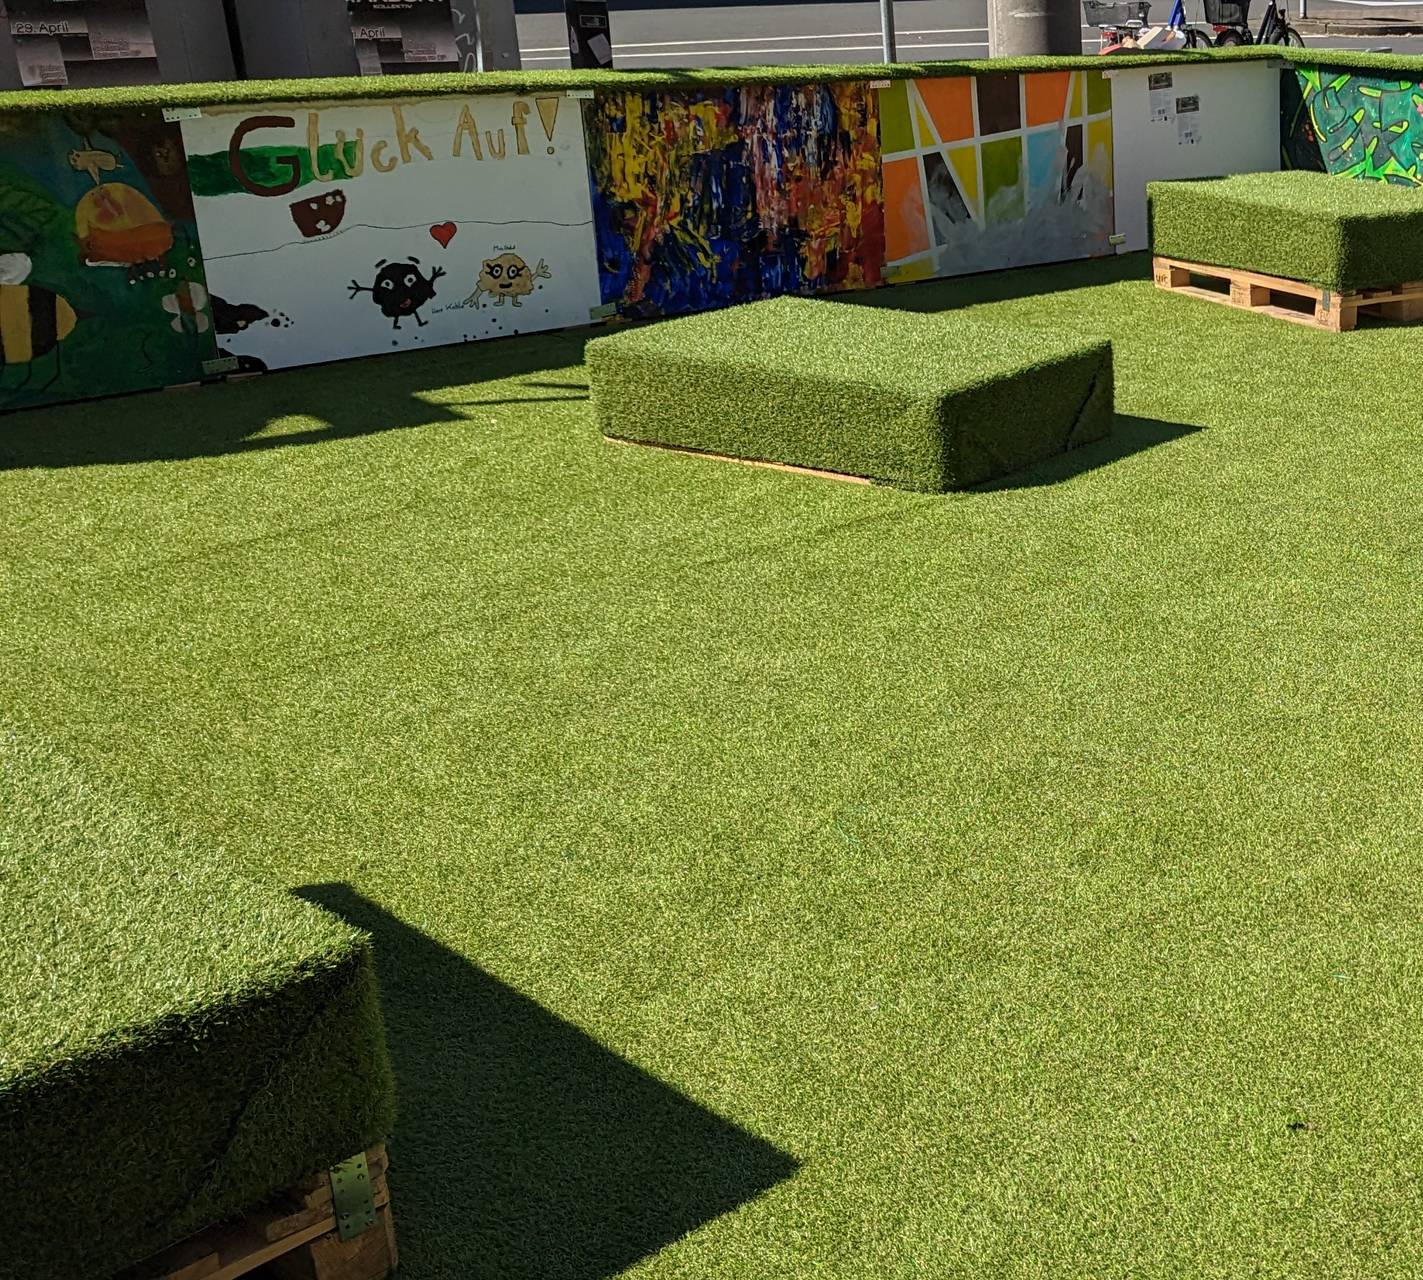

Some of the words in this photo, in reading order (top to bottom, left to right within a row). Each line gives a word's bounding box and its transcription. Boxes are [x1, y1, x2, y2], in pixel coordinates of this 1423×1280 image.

[39, 21, 69, 35] April
[360, 27, 385, 40] April
[452, 97, 560, 162] Auf!
